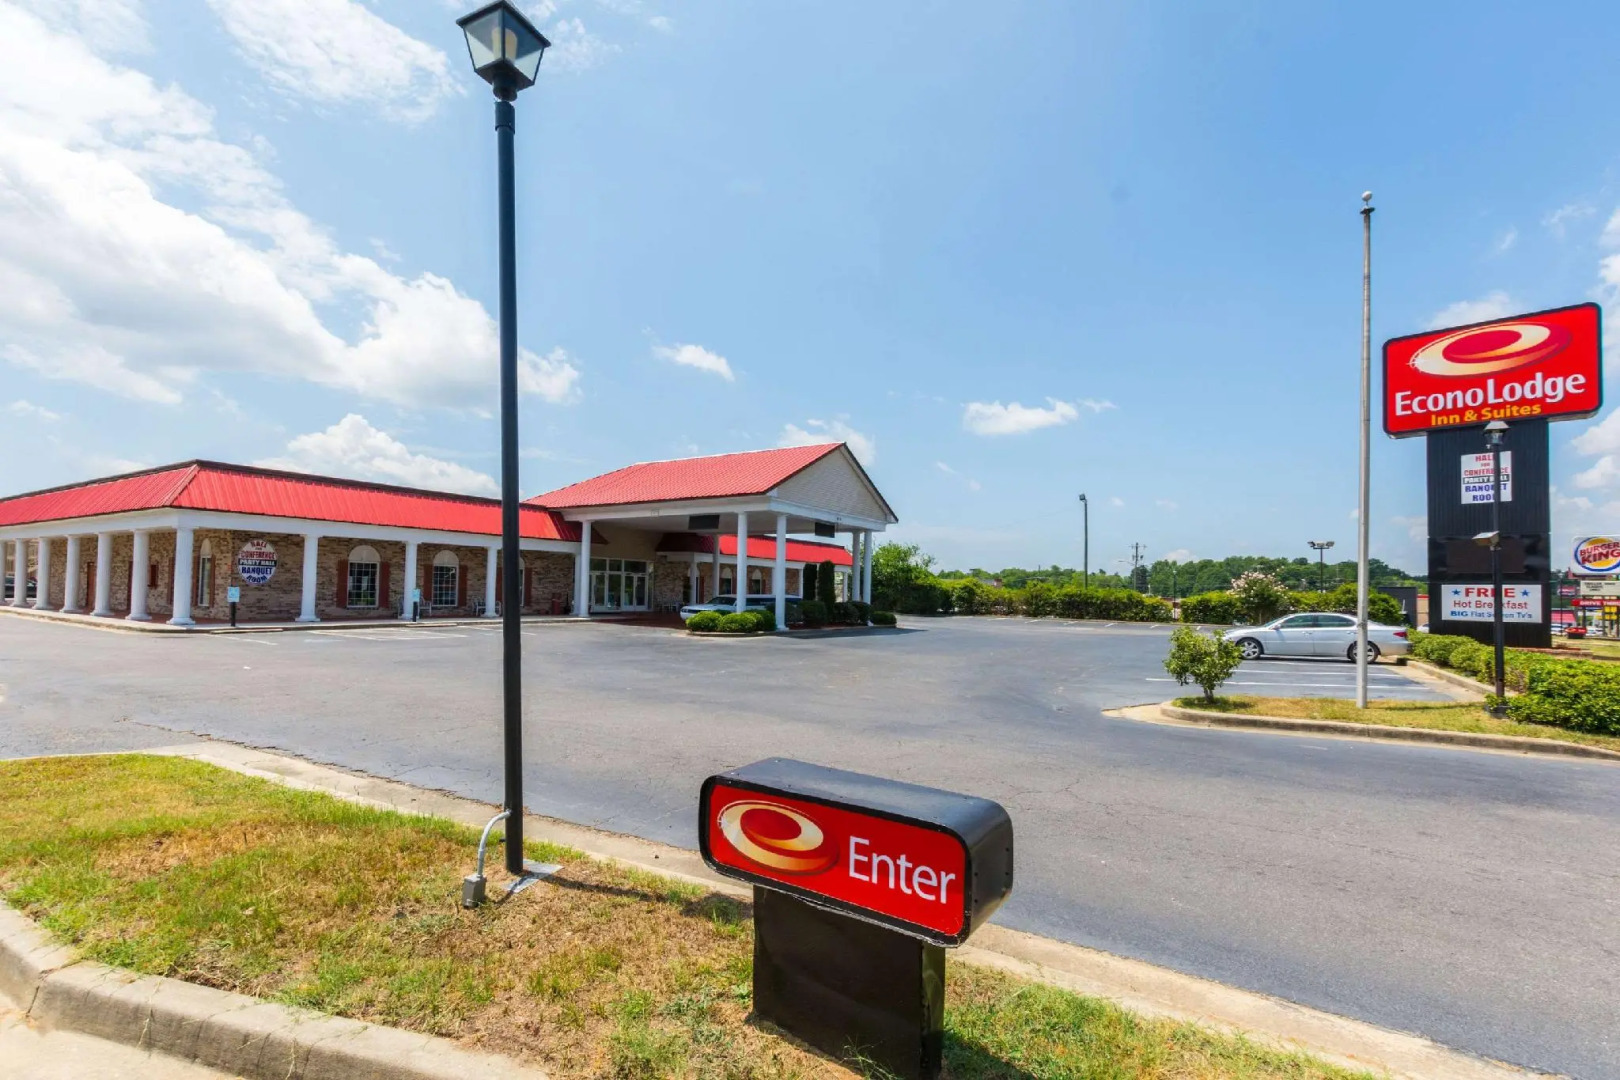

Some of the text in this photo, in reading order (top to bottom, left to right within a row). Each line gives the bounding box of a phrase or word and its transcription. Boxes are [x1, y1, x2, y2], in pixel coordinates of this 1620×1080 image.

[1395, 372, 1586, 416] EconoLodge
[1431, 404, 1541, 426] Inn & Suites
[1475, 454, 1494, 462] HAL
[1464, 467, 1509, 476] CONFERECE
[1580, 542, 1620, 556] BURGER
[1581, 549, 1620, 565] KING
[242, 567, 272, 575] BANQUET
[1453, 600, 1471, 608] Hot
[849, 835, 956, 904] Enter
